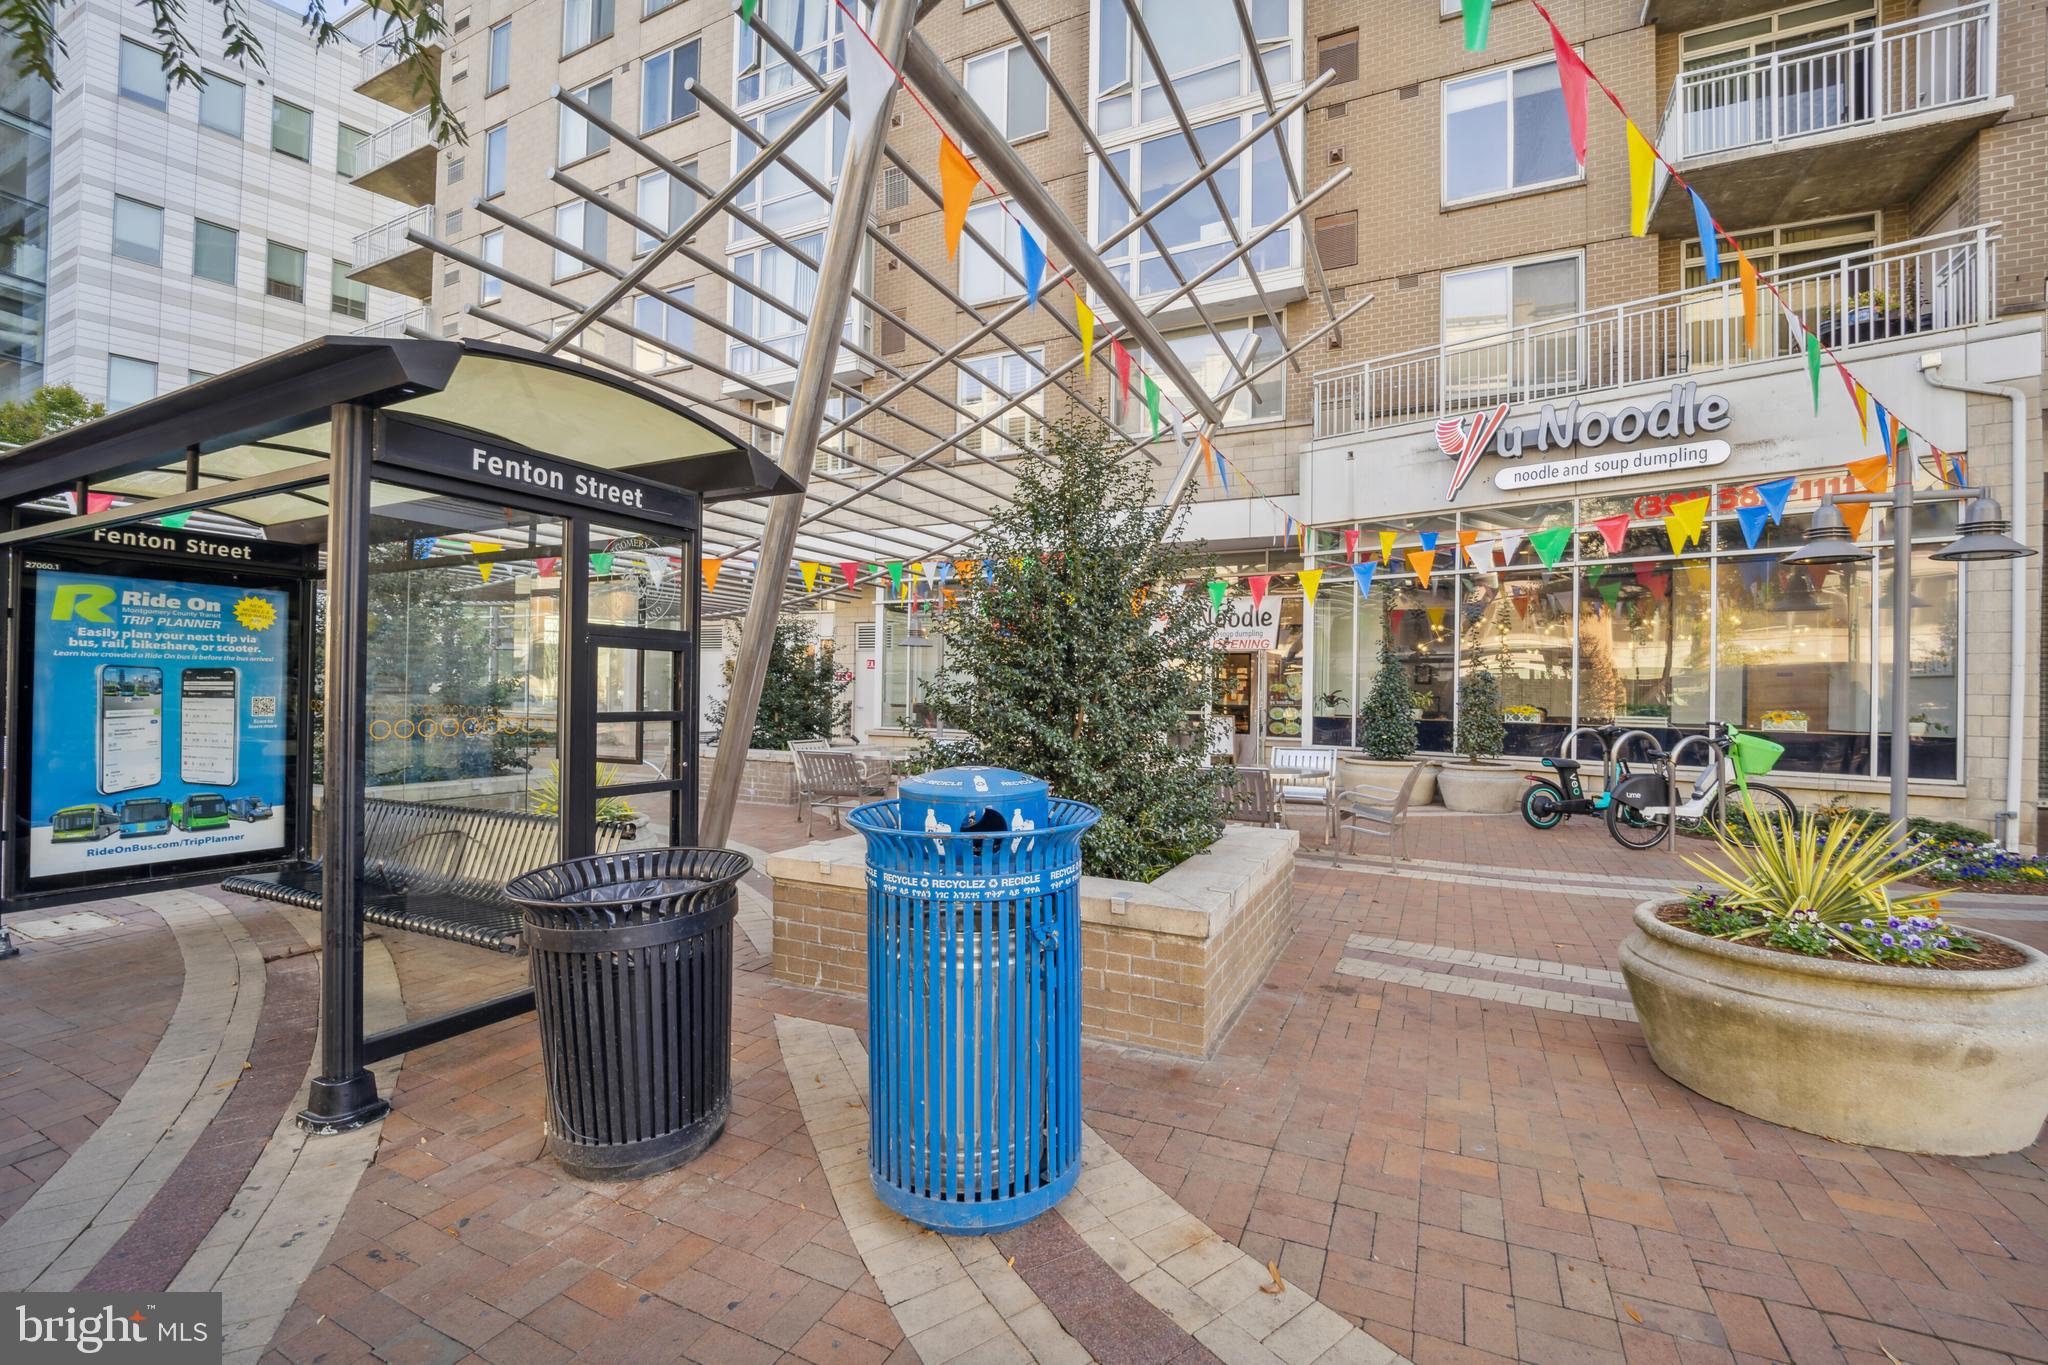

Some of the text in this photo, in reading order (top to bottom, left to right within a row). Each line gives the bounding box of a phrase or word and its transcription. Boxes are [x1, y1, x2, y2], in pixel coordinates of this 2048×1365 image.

[1537, 381, 1733, 452] Noodle
[1513, 447, 1709, 483] noodle and soup dumpling
[472, 447, 643, 508] Fenton Street
[93, 528, 252, 560] Fenton Street
[25, 561, 60, 570] 27060.1
[121, 591, 222, 612] Ride On
[121, 607, 170, 616] Montgomery
[172, 609, 198, 618] County
[122, 615, 222, 629] TRIP PLANNER
[78, 627, 257, 644] Easily plan your next trip via
[68, 637, 98, 648] bus,
[101, 639, 129, 649] rail,
[131, 640, 199, 652] bikeshare,
[216, 644, 261, 653] scooter.
[86, 833, 245, 857] RideOnBus.com/TripPlanner
[883, 872, 918, 887] RECYCLE
[932, 879, 986, 889] RECYCLEZ
[1001, 874, 1041, 887] RECICLE
[1050, 864, 1076, 880] RECYCLE
